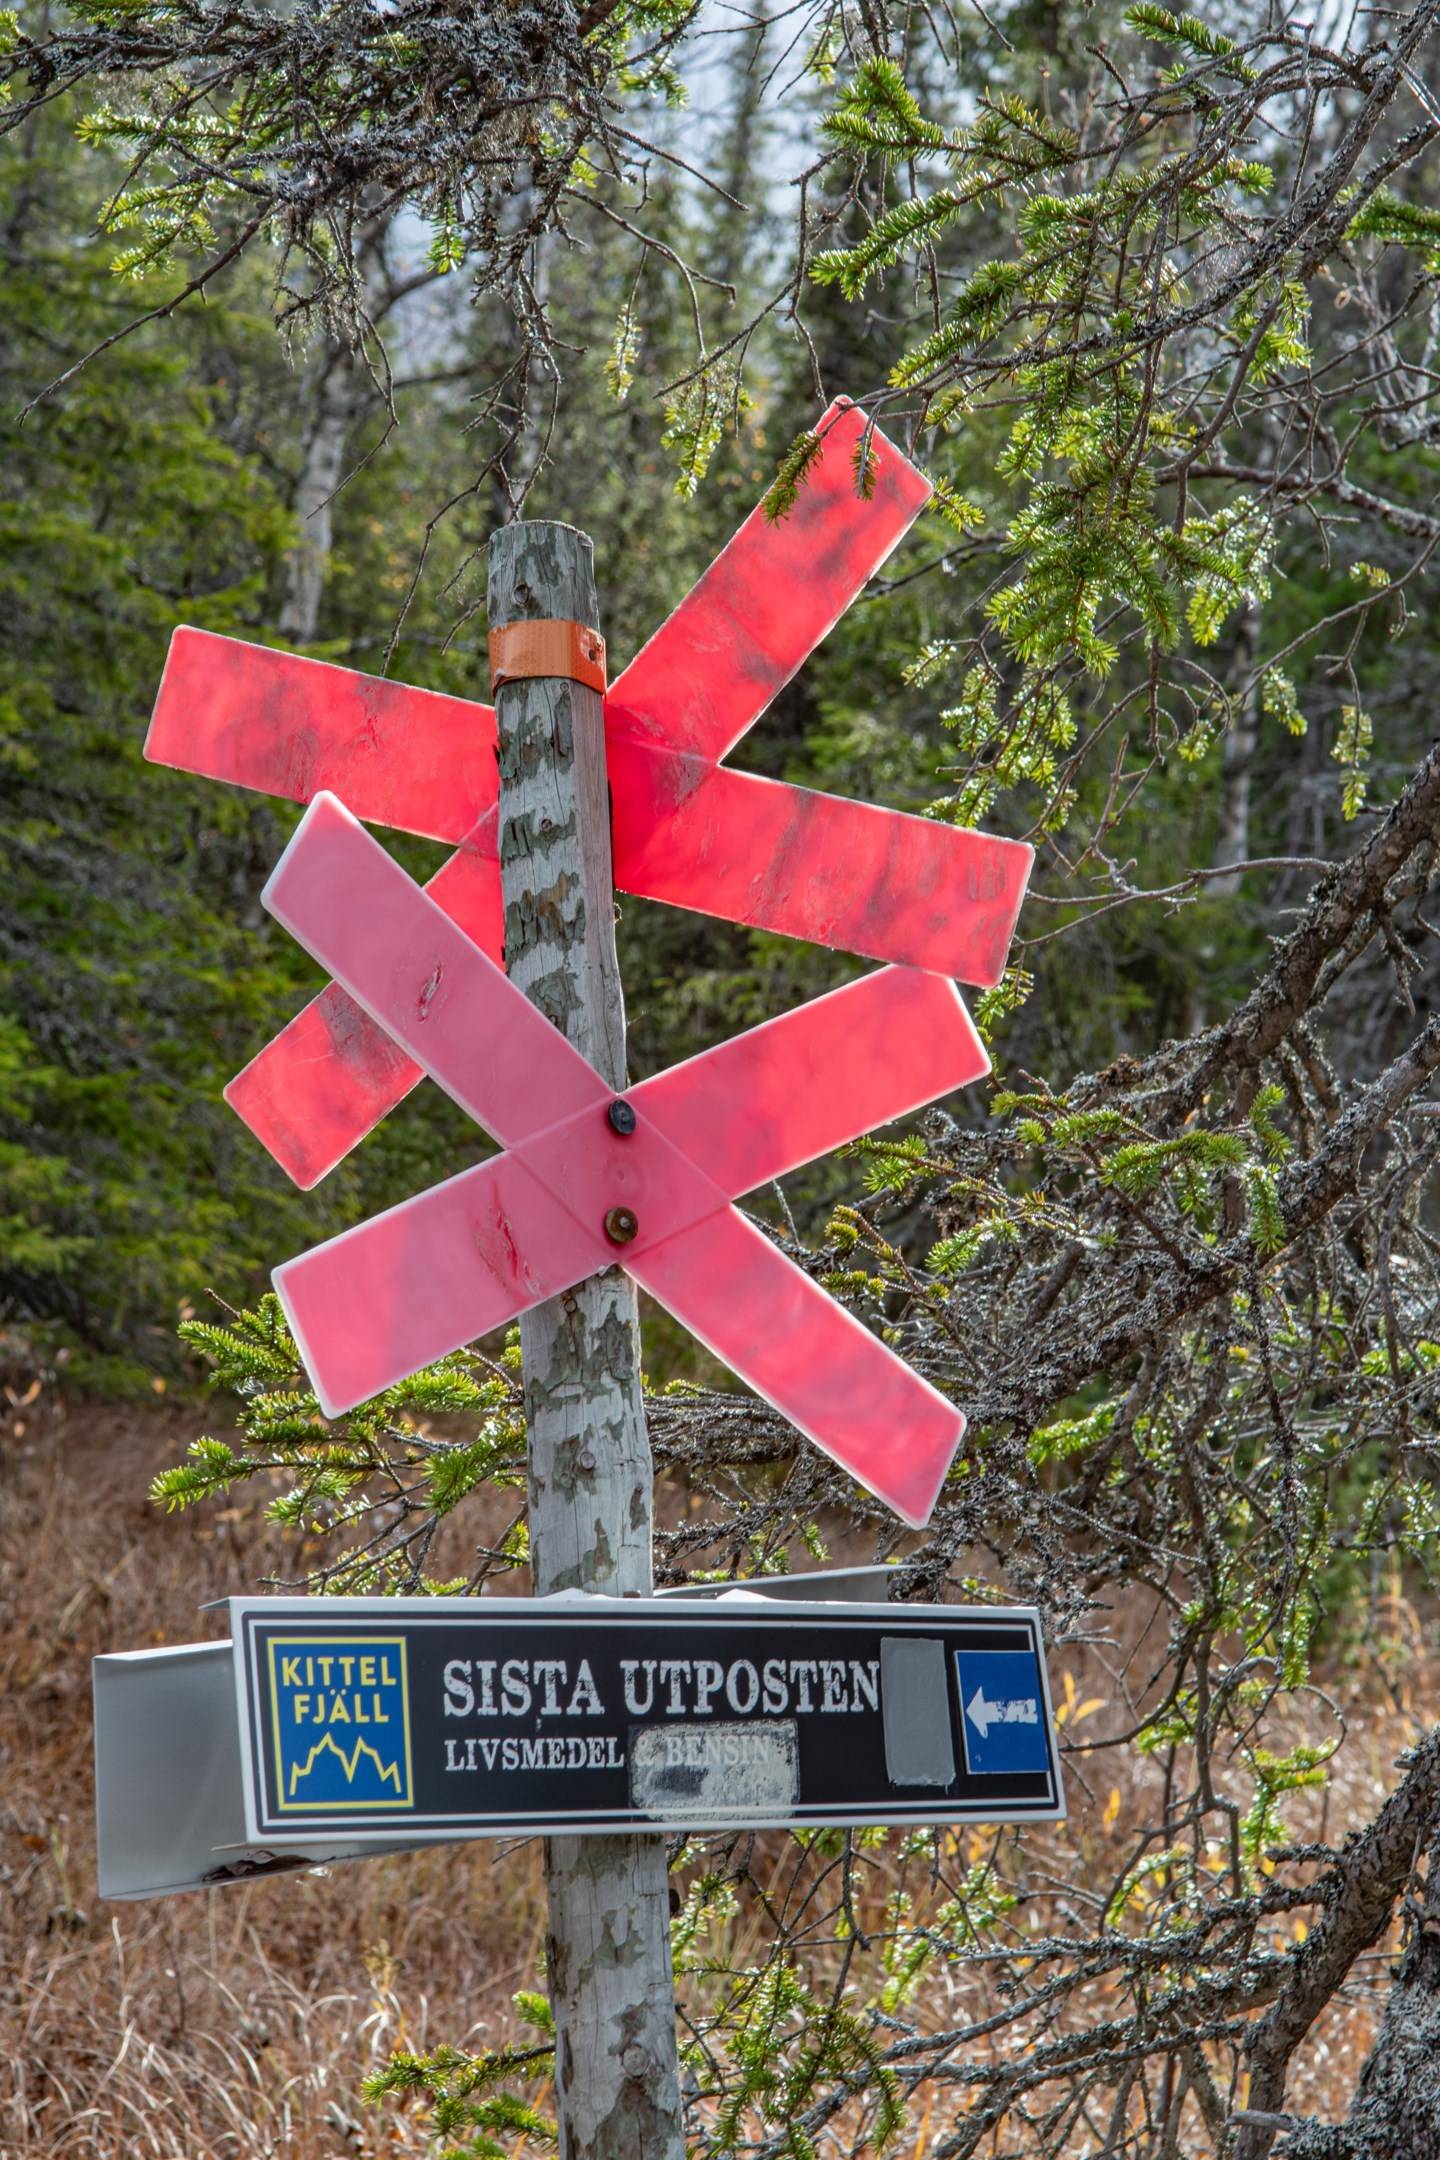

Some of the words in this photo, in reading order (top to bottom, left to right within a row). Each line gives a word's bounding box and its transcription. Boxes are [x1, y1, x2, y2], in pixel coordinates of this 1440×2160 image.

[281, 1656, 397, 1687] KITTEL
[443, 1658, 605, 1718] SISTA
[619, 1658, 881, 1715] UTPOSTEN
[294, 1689, 390, 1724] FJÄLL
[444, 1737, 624, 1771] LIVSMEDEL
[665, 1734, 771, 1766] BENSIN
